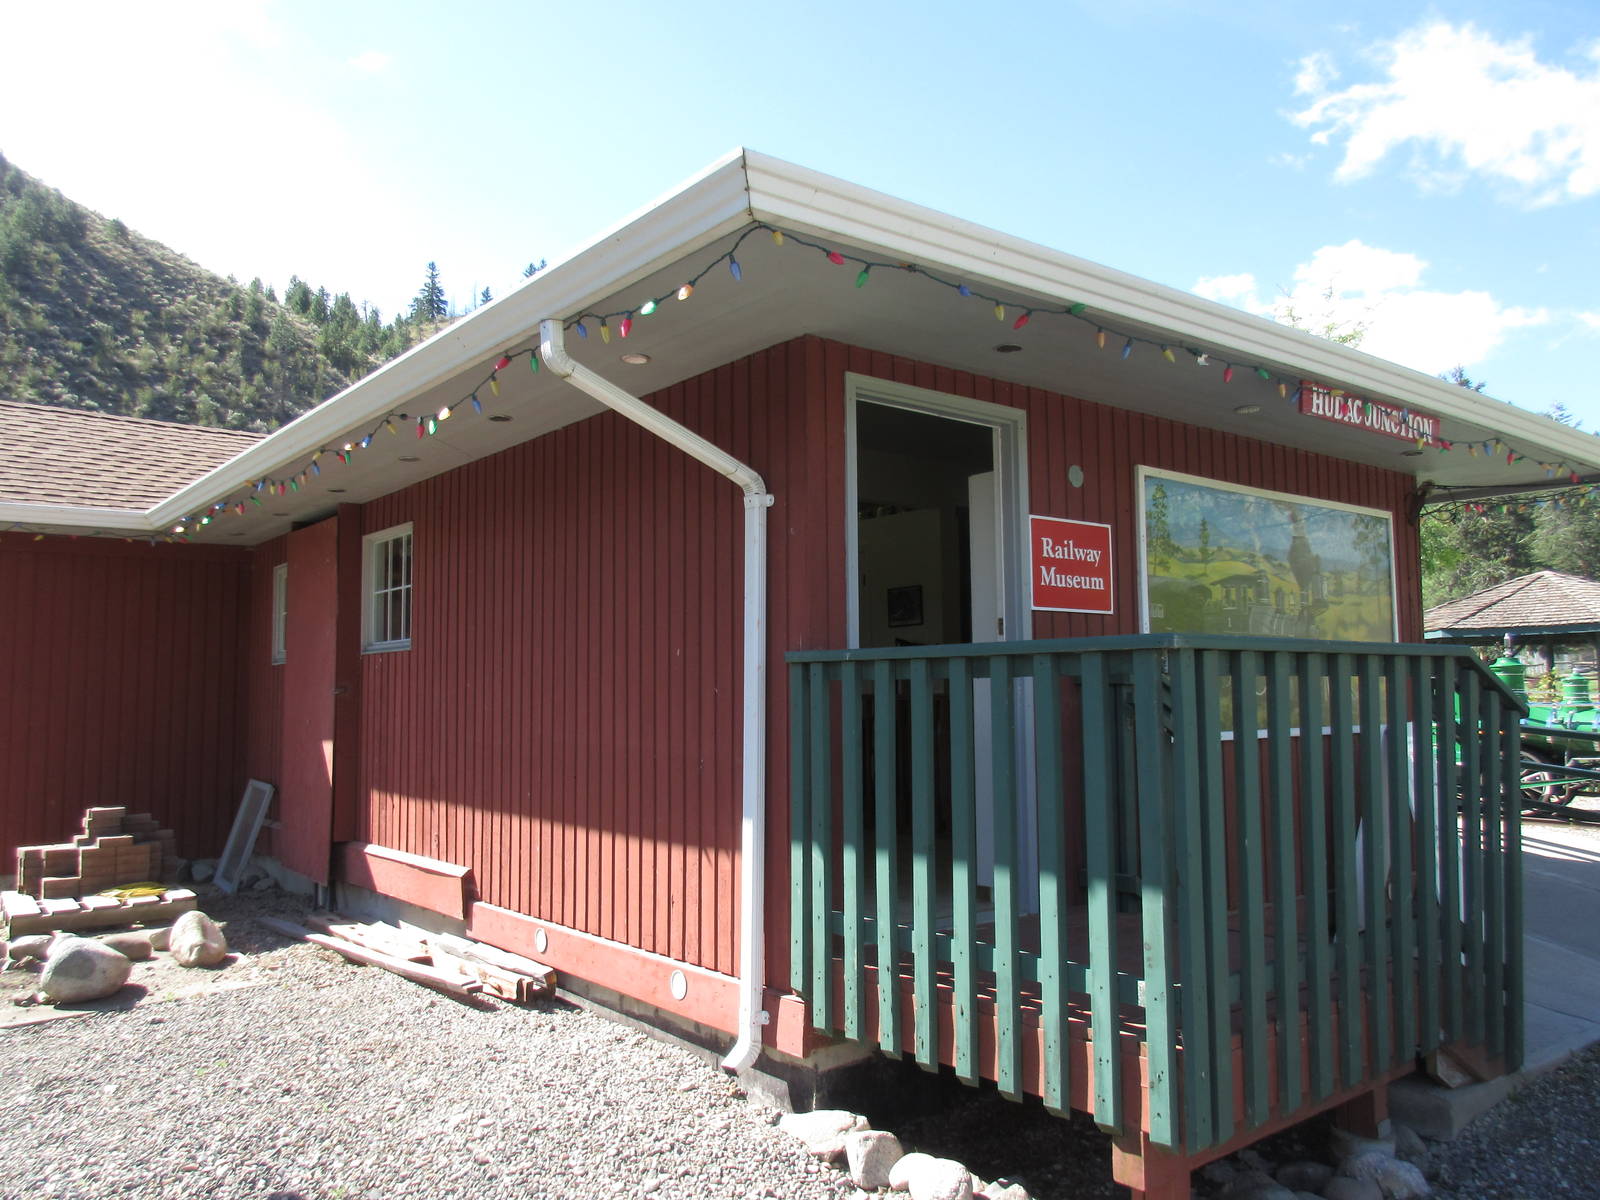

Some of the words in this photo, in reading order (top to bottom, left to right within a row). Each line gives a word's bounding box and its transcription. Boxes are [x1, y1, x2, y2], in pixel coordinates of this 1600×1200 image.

[1312, 387, 1362, 424] HUDAC
[1040, 537, 1102, 567] Railway
[1039, 565, 1105, 590] Museum
